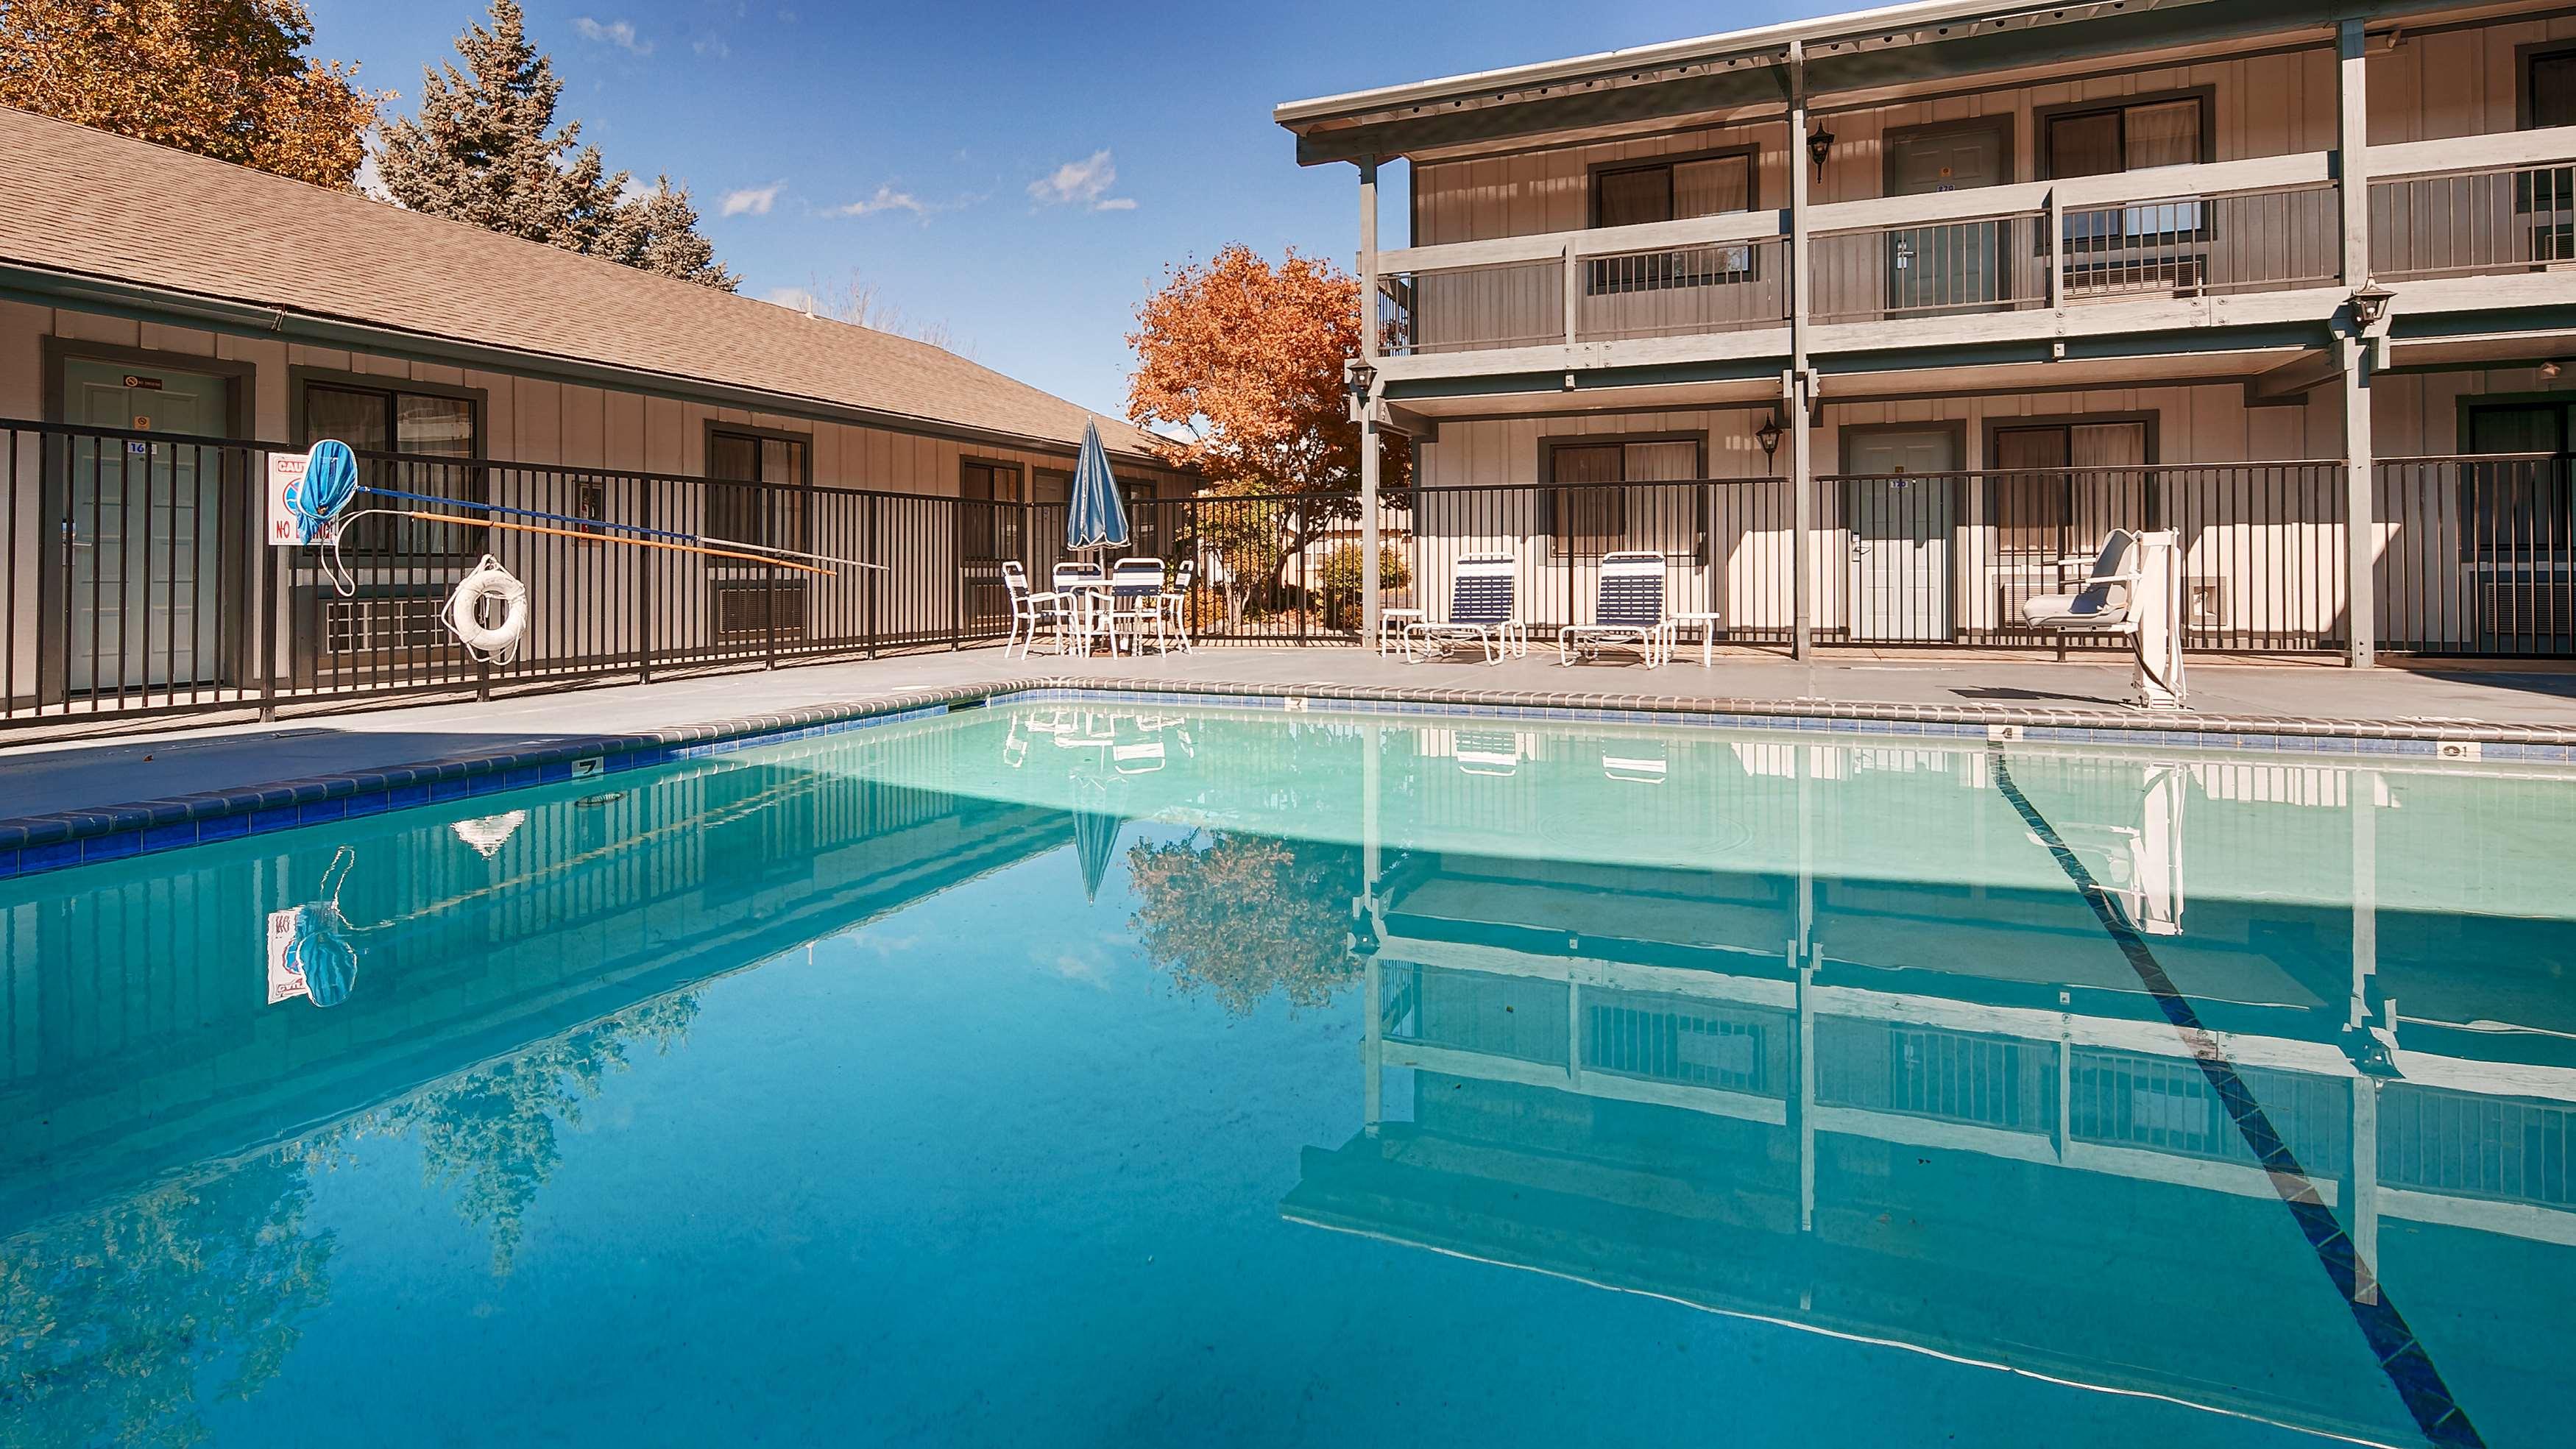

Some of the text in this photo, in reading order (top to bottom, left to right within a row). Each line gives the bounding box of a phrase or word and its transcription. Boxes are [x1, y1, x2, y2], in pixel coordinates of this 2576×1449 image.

[131, 443, 150, 453] 16
[278, 461, 303, 472] CAU
[276, 520, 290, 539] NO
[579, 759, 597, 775] 7
